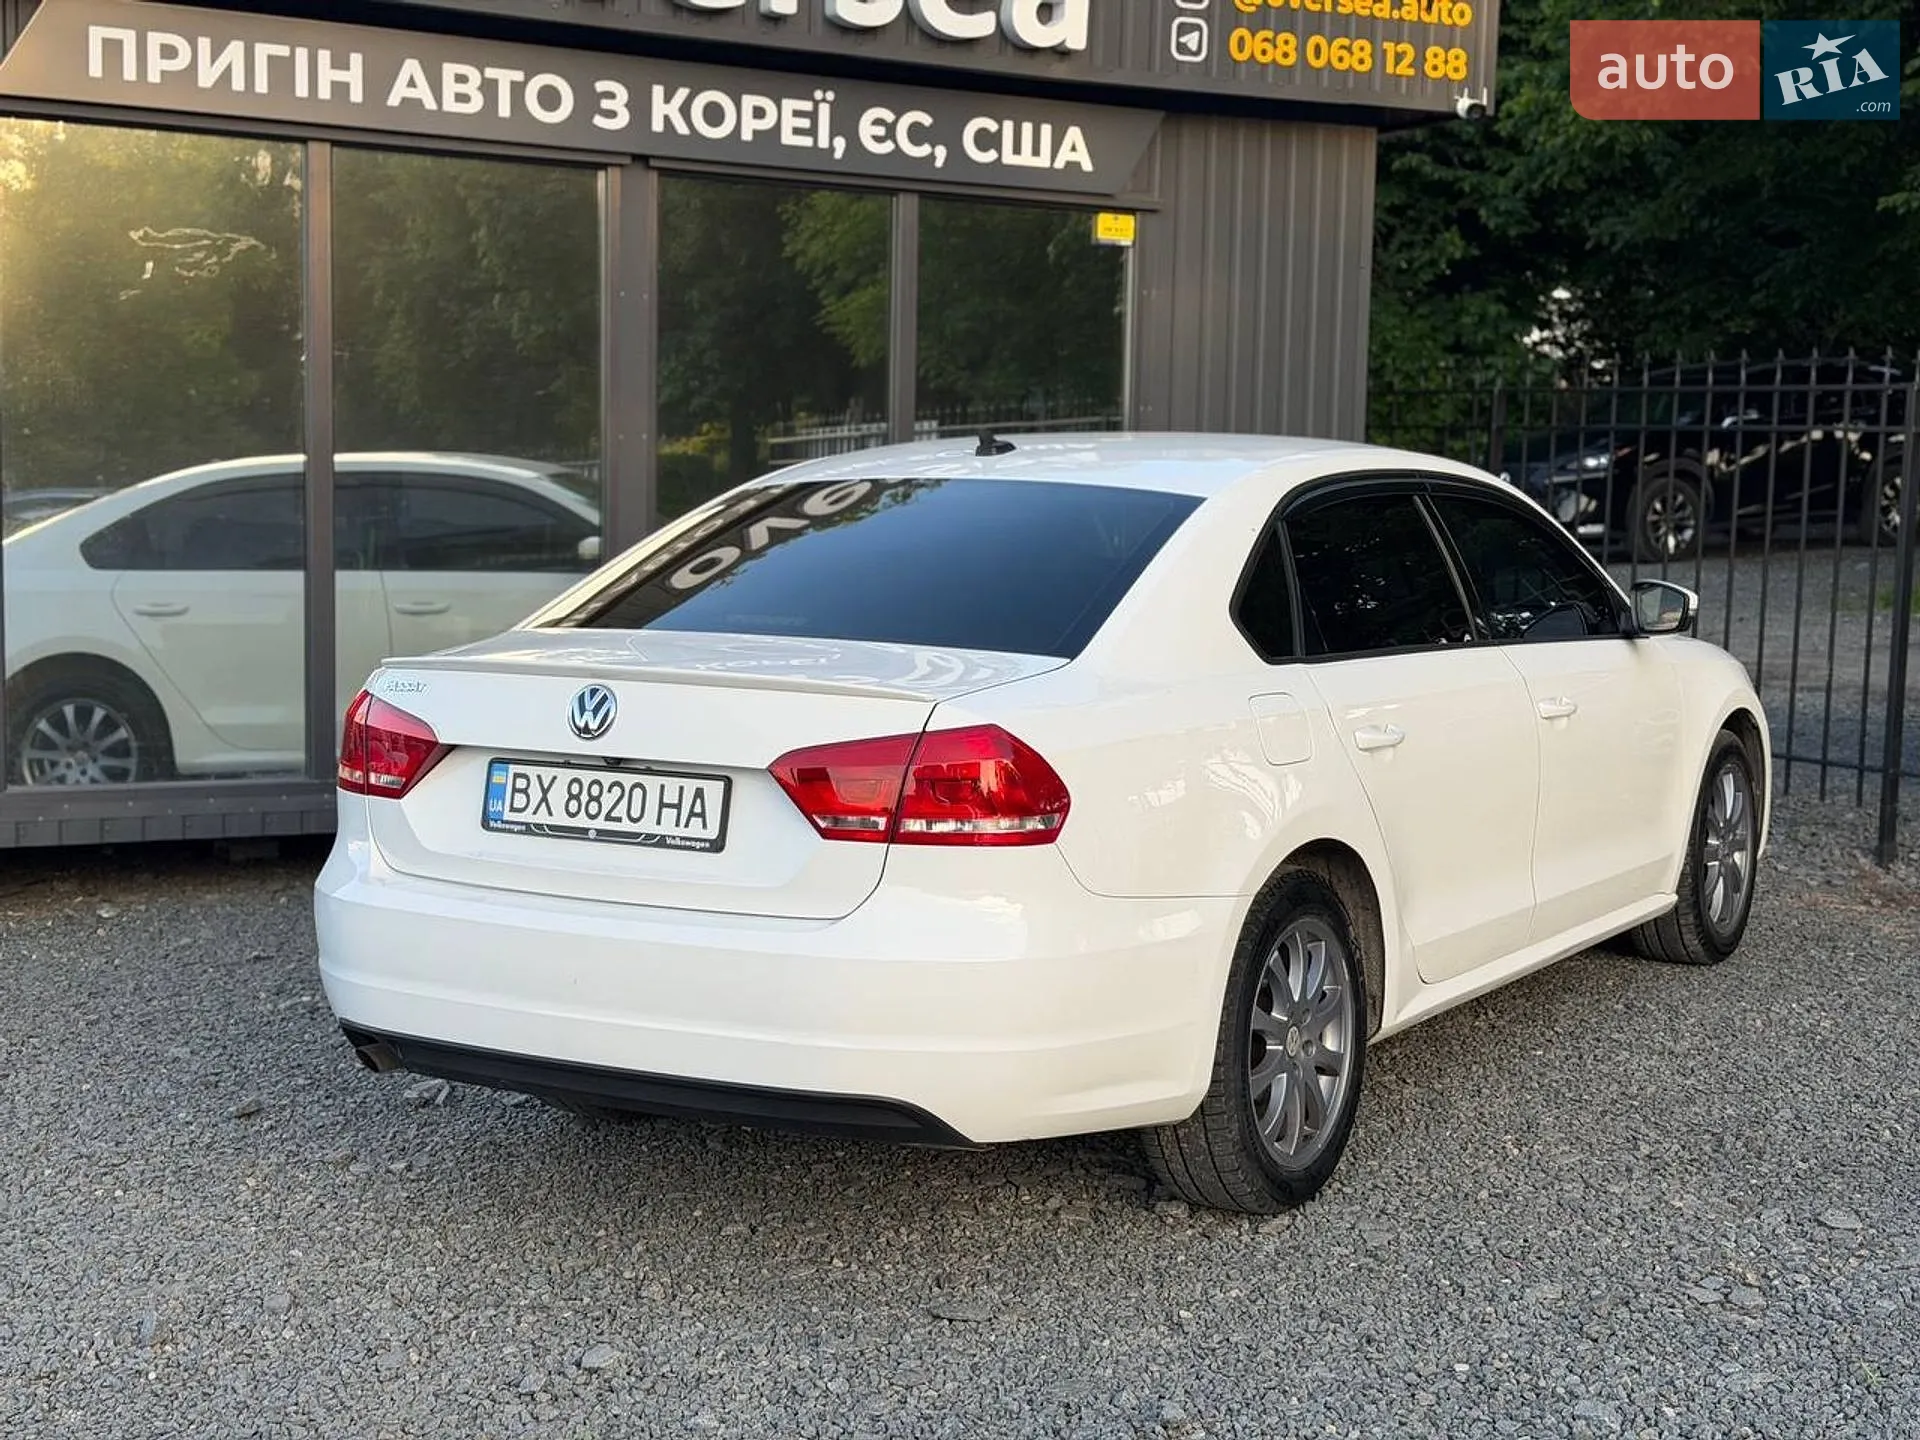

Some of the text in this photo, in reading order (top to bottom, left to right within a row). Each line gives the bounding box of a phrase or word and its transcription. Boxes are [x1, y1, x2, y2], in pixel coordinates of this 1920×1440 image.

[1229, 27, 1468, 81] 068 068 12 88
[87, 25, 363, 103] ПРИГІН
[386, 58, 574, 124] АВТО
[650, 84, 846, 160] КОРЕЇ,
[858, 106, 948, 169] ЄС,
[962, 117, 1094, 173] США
[489, 797, 503, 812] UA
[508, 772, 708, 830] BX 8820 HA
